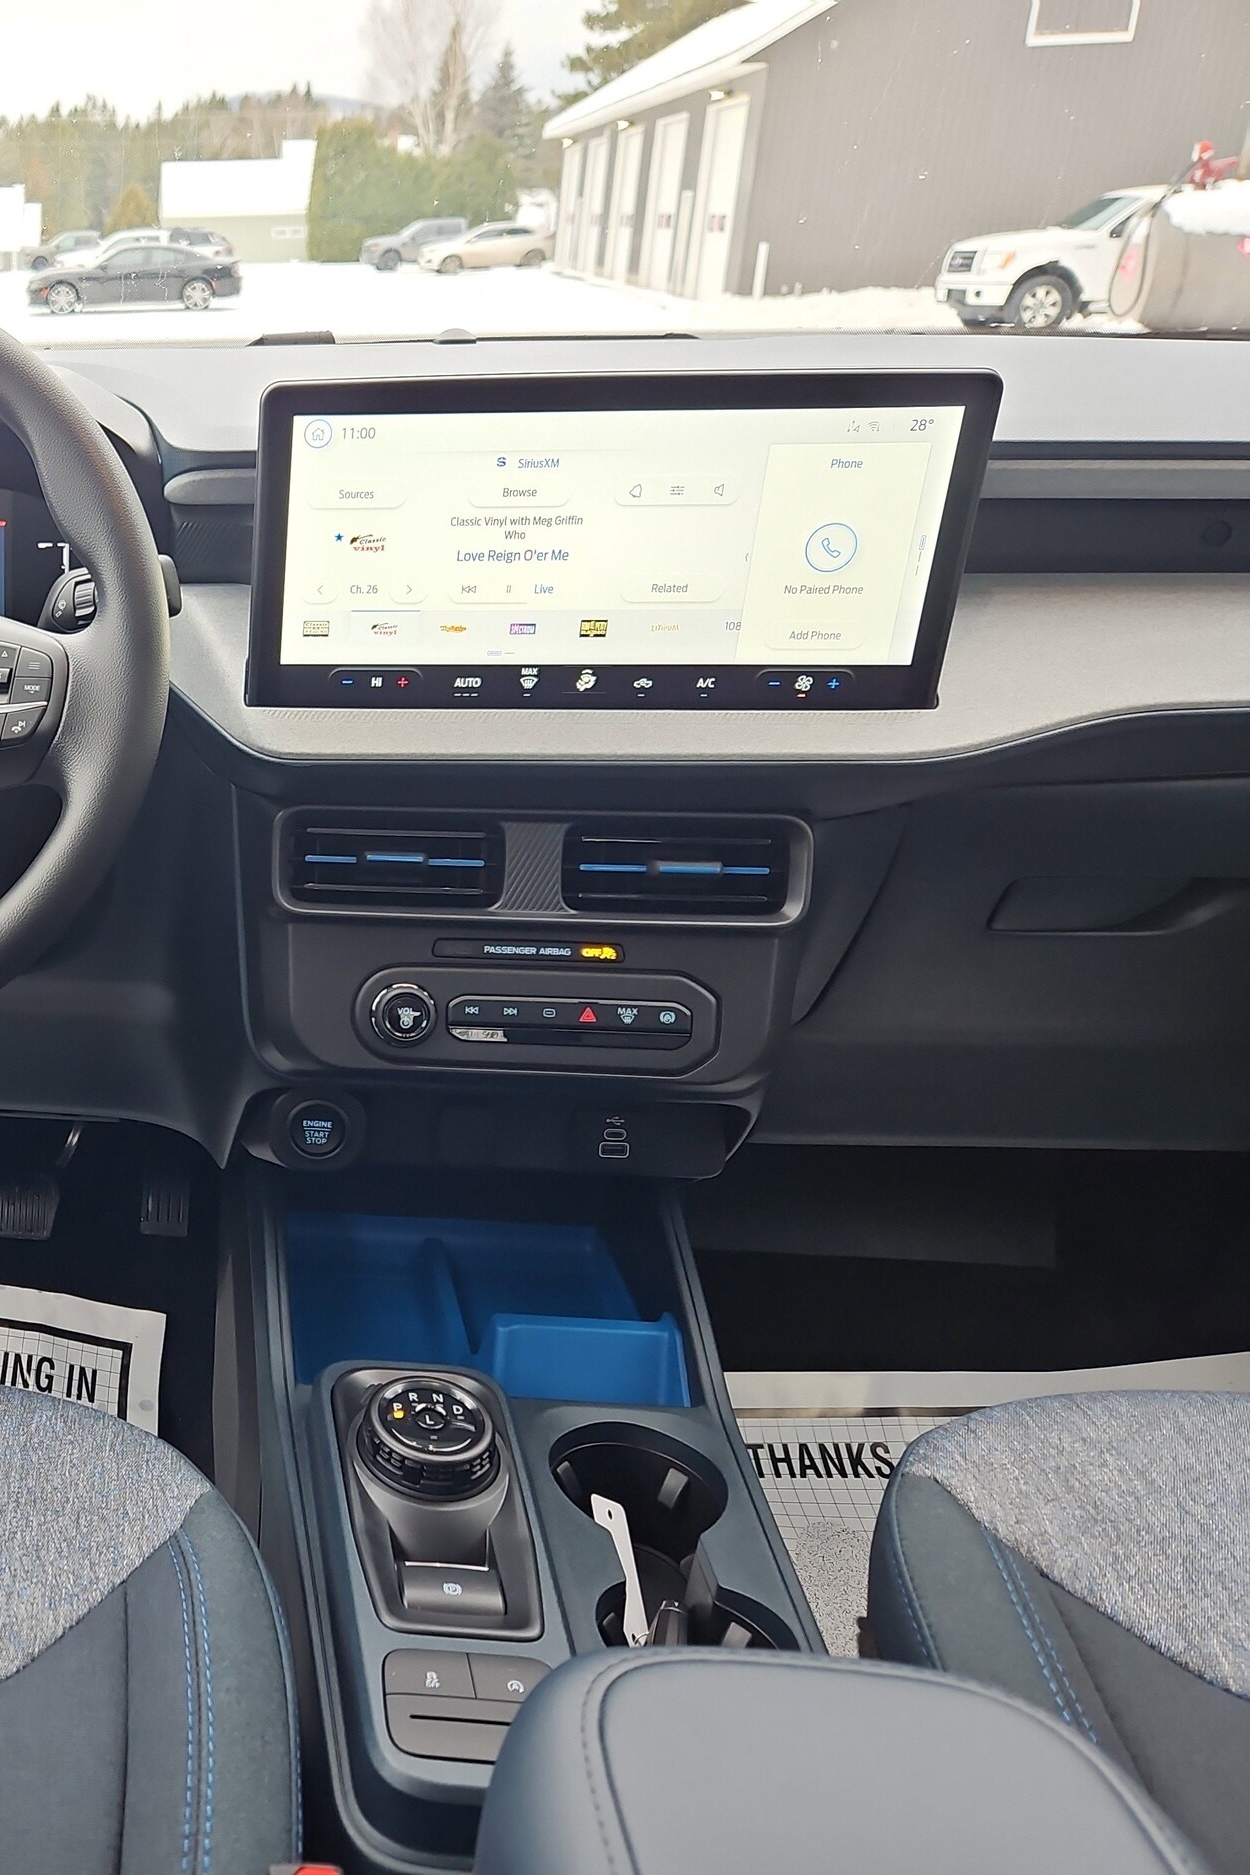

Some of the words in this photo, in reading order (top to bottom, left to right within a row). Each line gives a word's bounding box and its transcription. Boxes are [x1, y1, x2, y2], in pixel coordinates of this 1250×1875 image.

[910, 419, 935, 432] 28°
[341, 427, 376, 440] 11:00
[518, 458, 560, 470] SiriusXM
[830, 458, 864, 469] Phone
[338, 489, 375, 500] Sources
[502, 487, 538, 498] Browse
[450, 516, 482, 527] Classic
[484, 516, 508, 528] Vinyl
[509, 516, 531, 527] with
[532, 516, 553, 528] Meg
[554, 515, 584, 527] Griffin
[504, 530, 526, 541] Who
[353, 544, 385, 553] vinyl
[456, 550, 485, 562] Love
[487, 550, 521, 563] Reign
[523, 549, 548, 562] O'er
[551, 549, 569, 561] Me
[350, 584, 365, 595] Ch.
[366, 584, 378, 595] 26
[534, 584, 554, 595] Live
[651, 583, 688, 594] Related
[784, 585, 797, 595] No
[799, 584, 830, 595] Paired
[832, 584, 864, 595] Phone
[789, 630, 809, 641] Add
[810, 630, 841, 641] Phone
[521, 667, 539, 675] MAX
[370, 677, 383, 687] HI
[453, 677, 482, 688] AUTO
[696, 678, 716, 688] A/C
[483, 945, 537, 955] PASSENGER
[538, 947, 572, 956] AIRBAG
[397, 1007, 414, 1015] VOL
[617, 1007, 639, 1015] MAX
[302, 1120, 333, 1129] ENGINE
[65, 1364, 99, 1404] IN
[408, 1392, 419, 1402] R
[432, 1393, 444, 1403] N
[392, 1402, 403, 1412] P
[452, 1404, 464, 1415] D
[425, 1414, 435, 1425] L
[747, 1442, 896, 1480] THANKS
